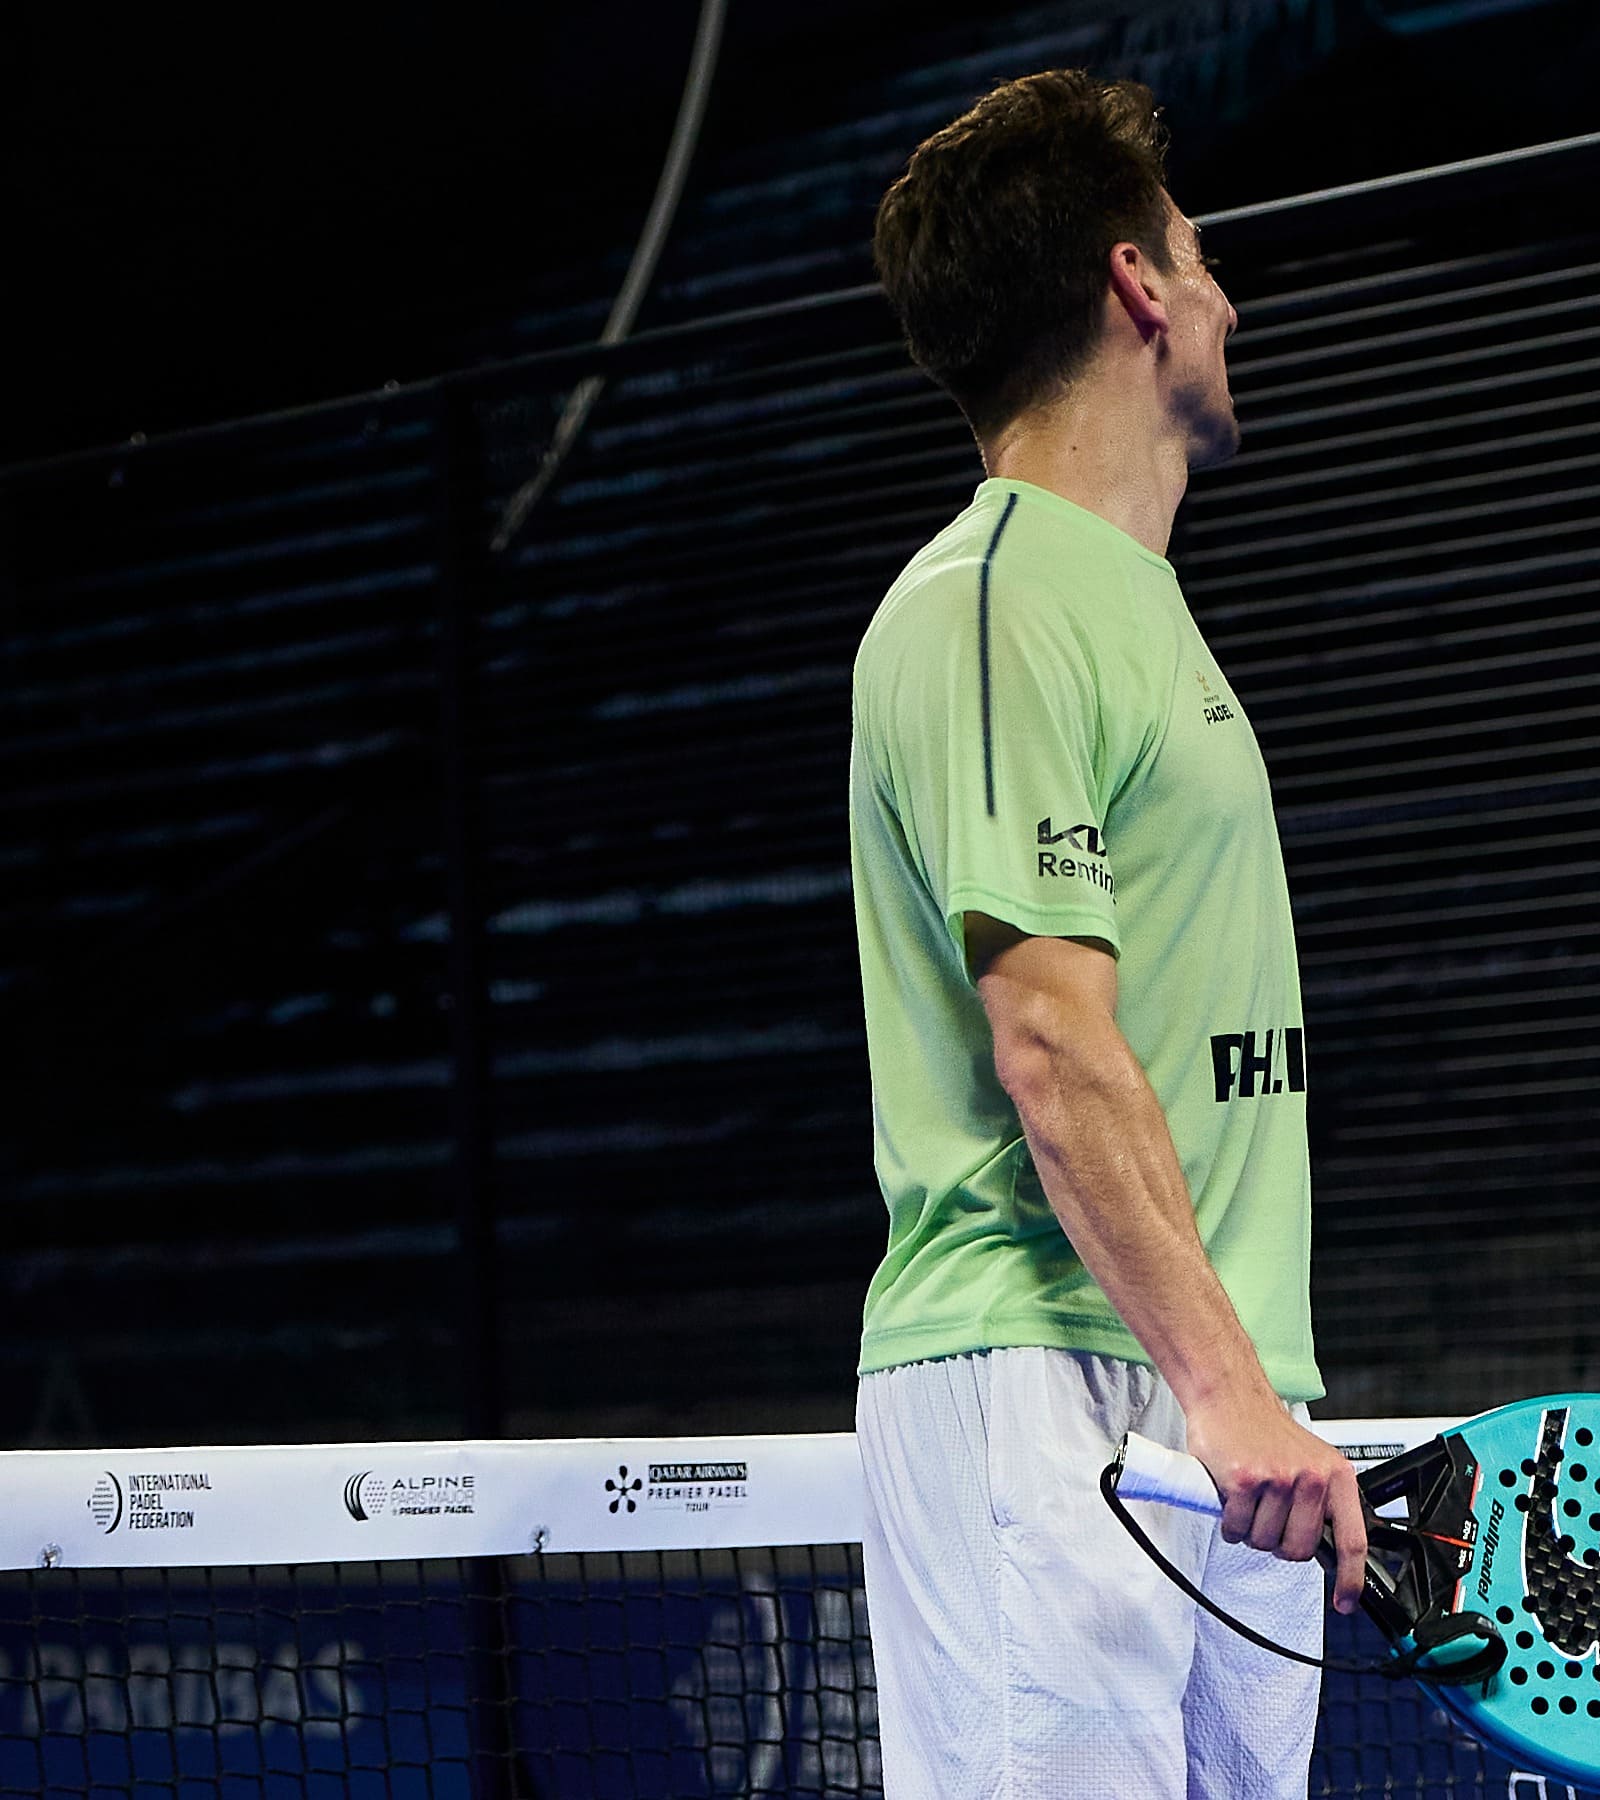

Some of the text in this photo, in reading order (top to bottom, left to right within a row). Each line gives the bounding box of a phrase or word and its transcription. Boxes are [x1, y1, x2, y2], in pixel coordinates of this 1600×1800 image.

[1203, 703, 1235, 726] PADEL
[1038, 851, 1115, 895] Rentin
[129, 1473, 212, 1491] INTERNATIONAL
[392, 1475, 475, 1490] ALPINE
[708, 1485, 747, 1498] PADEL
[129, 1493, 163, 1510] PADEL
[129, 1511, 194, 1529] FEDERATION
[1477, 1498, 1505, 1604] Bullpadel
